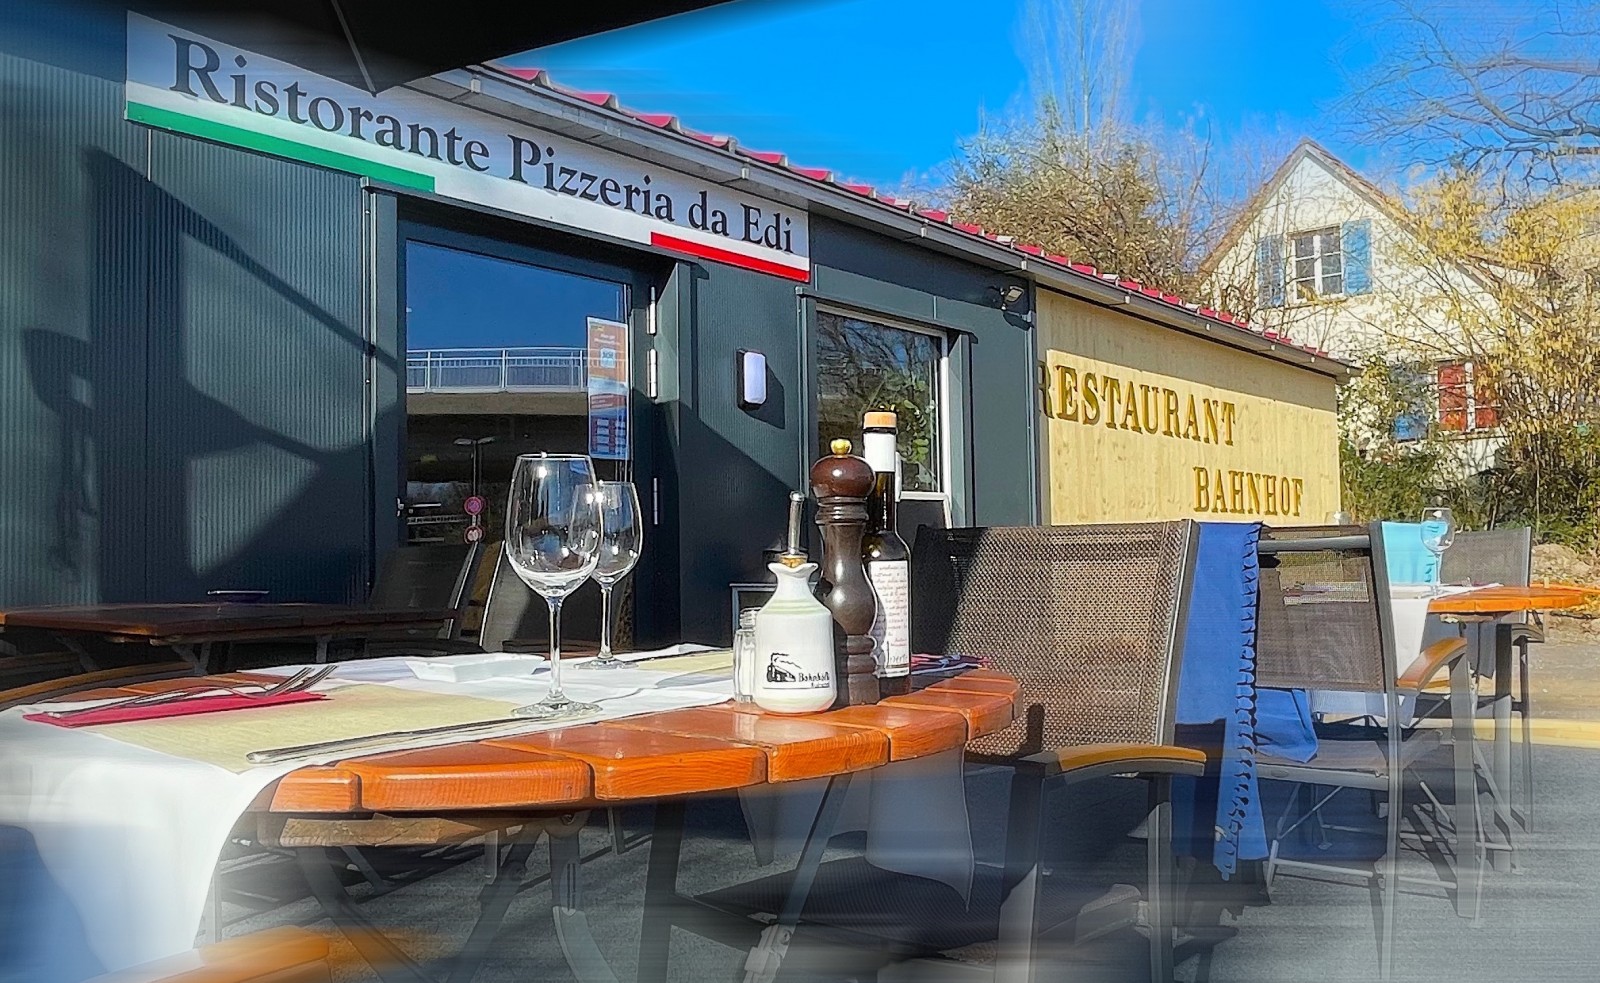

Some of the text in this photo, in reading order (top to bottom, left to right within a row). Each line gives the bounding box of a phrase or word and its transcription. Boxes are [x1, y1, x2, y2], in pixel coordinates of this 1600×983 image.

[168, 34, 794, 254] Ristorante Pizzeria da Edi
[1193, 466, 1304, 517] BAHNHOF
